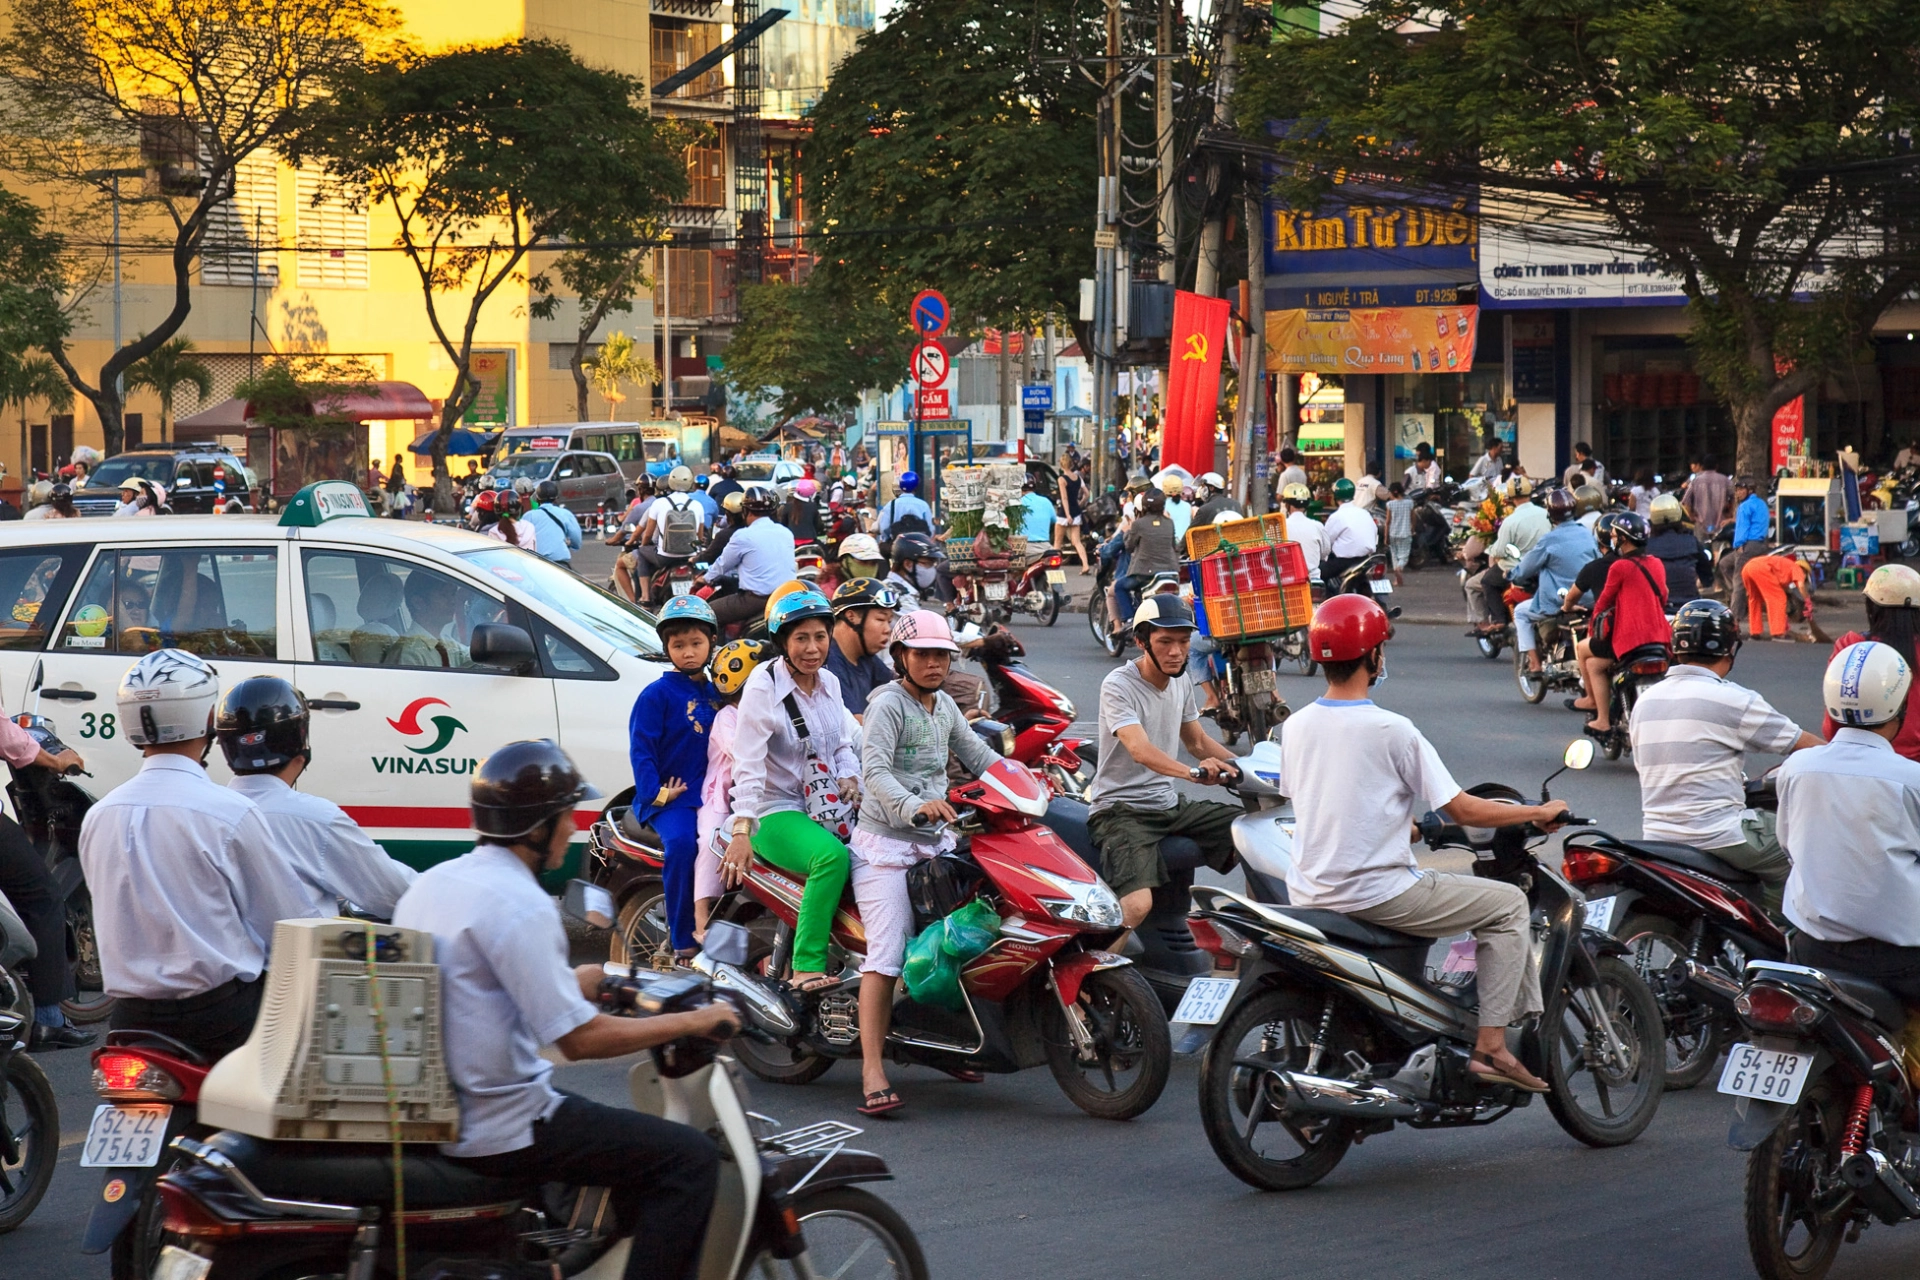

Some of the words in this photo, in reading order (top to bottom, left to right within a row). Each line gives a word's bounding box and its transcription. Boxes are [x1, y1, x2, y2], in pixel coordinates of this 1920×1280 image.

[1273, 208, 1348, 252] Kim
[1346, 205, 1401, 248] Từ
[1493, 263, 1523, 278] CÔNG
[1524, 265, 1538, 277] TY
[1540, 264, 1569, 276] TNHH
[921, 391, 942, 404] CẤM
[79, 712, 116, 740] 38
[808, 778, 830, 794] NY
[1008, 942, 1042, 953] HONDA
[1192, 981, 1230, 1000] 52-T8
[1182, 1001, 1219, 1021] 4734
[1740, 1049, 1799, 1076] 54-H3
[1732, 1070, 1791, 1098] 6190
[93, 1136, 151, 1163] 7543
